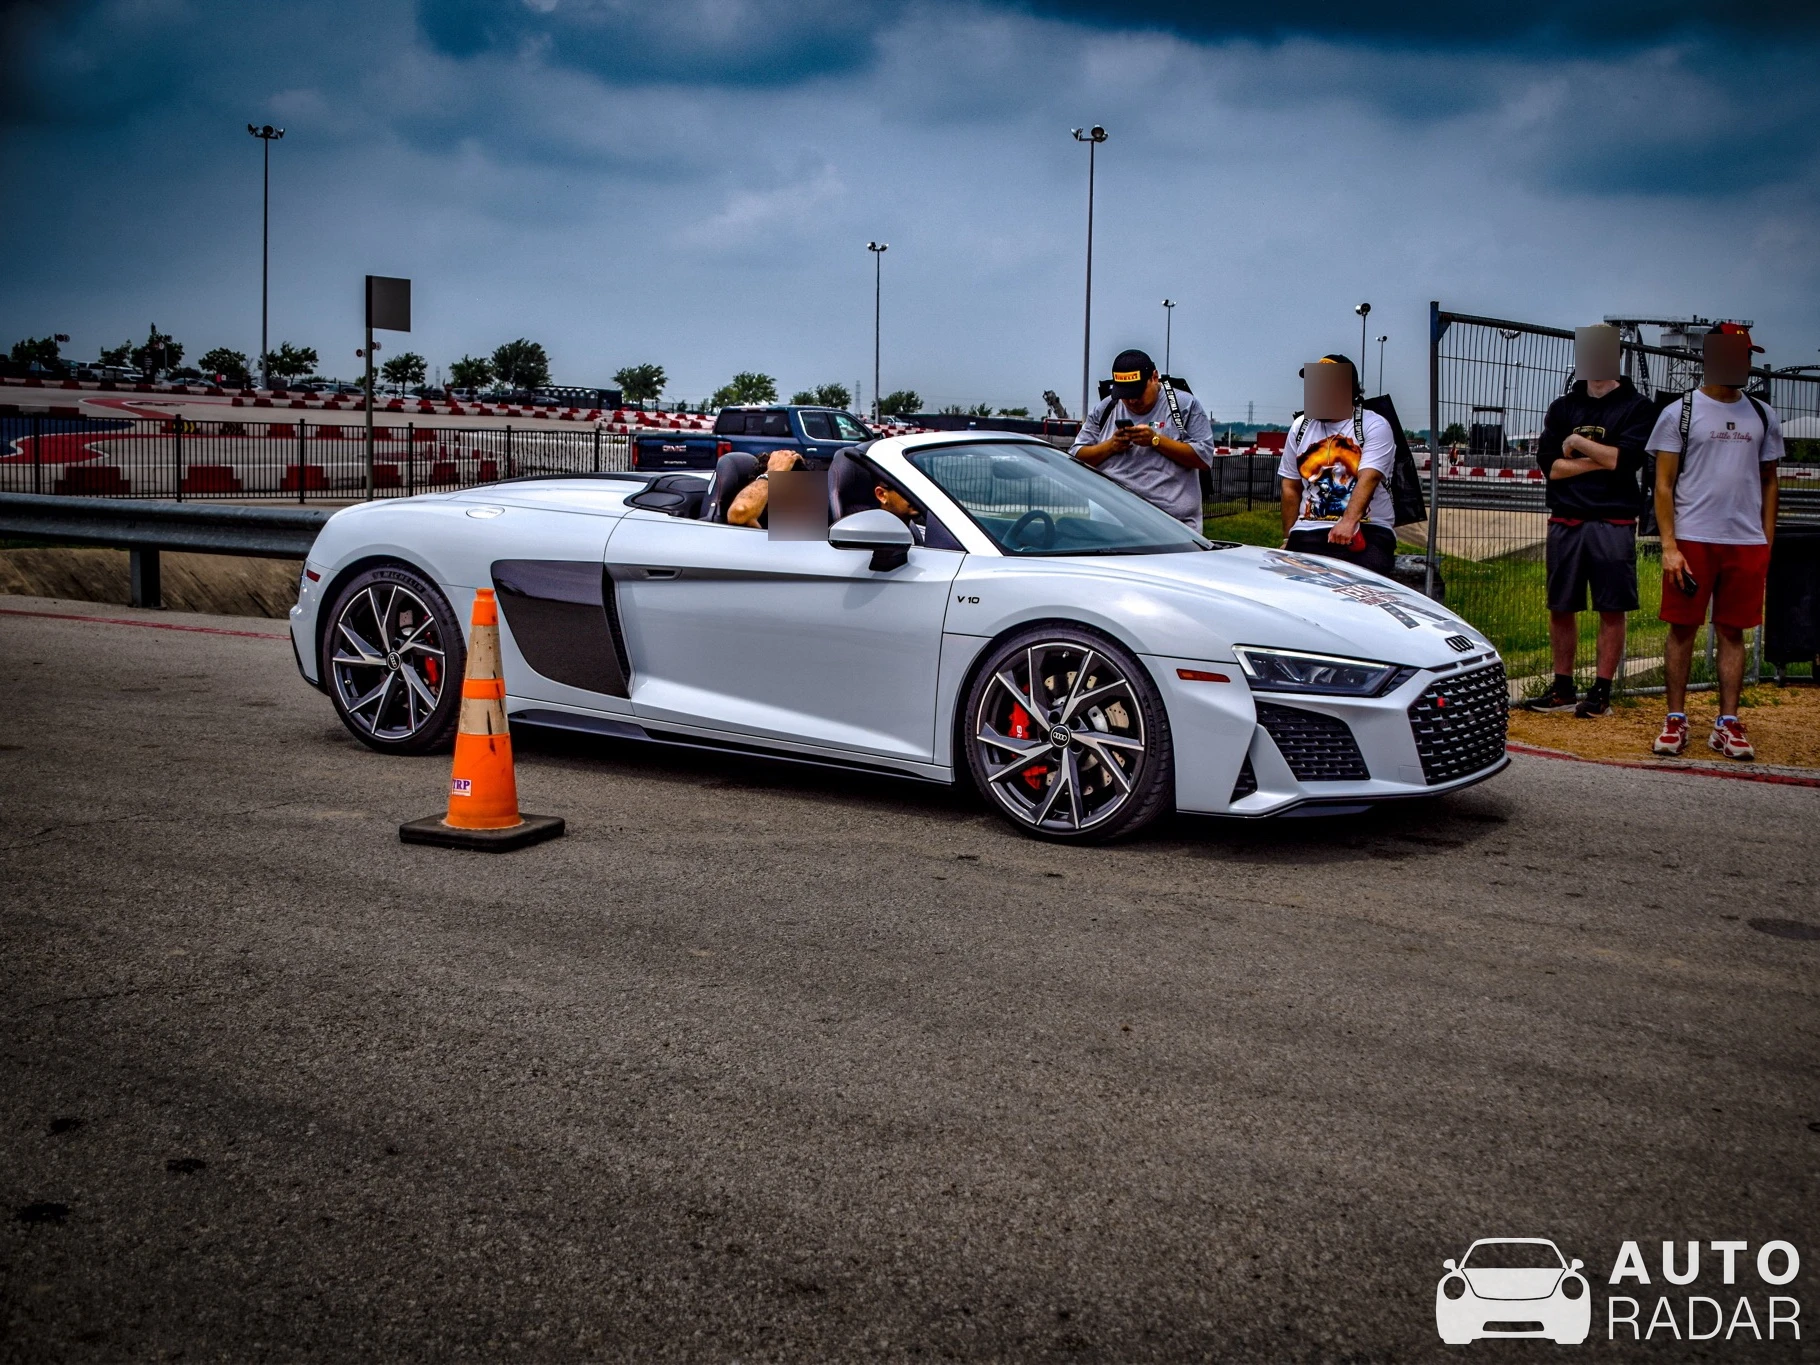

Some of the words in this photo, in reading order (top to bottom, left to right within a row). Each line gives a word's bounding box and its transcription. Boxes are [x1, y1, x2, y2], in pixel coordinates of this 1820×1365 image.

[1681, 410, 1690, 432] OPTIMA
[1710, 431, 1731, 440] Little
[1733, 431, 1752, 443] Italy
